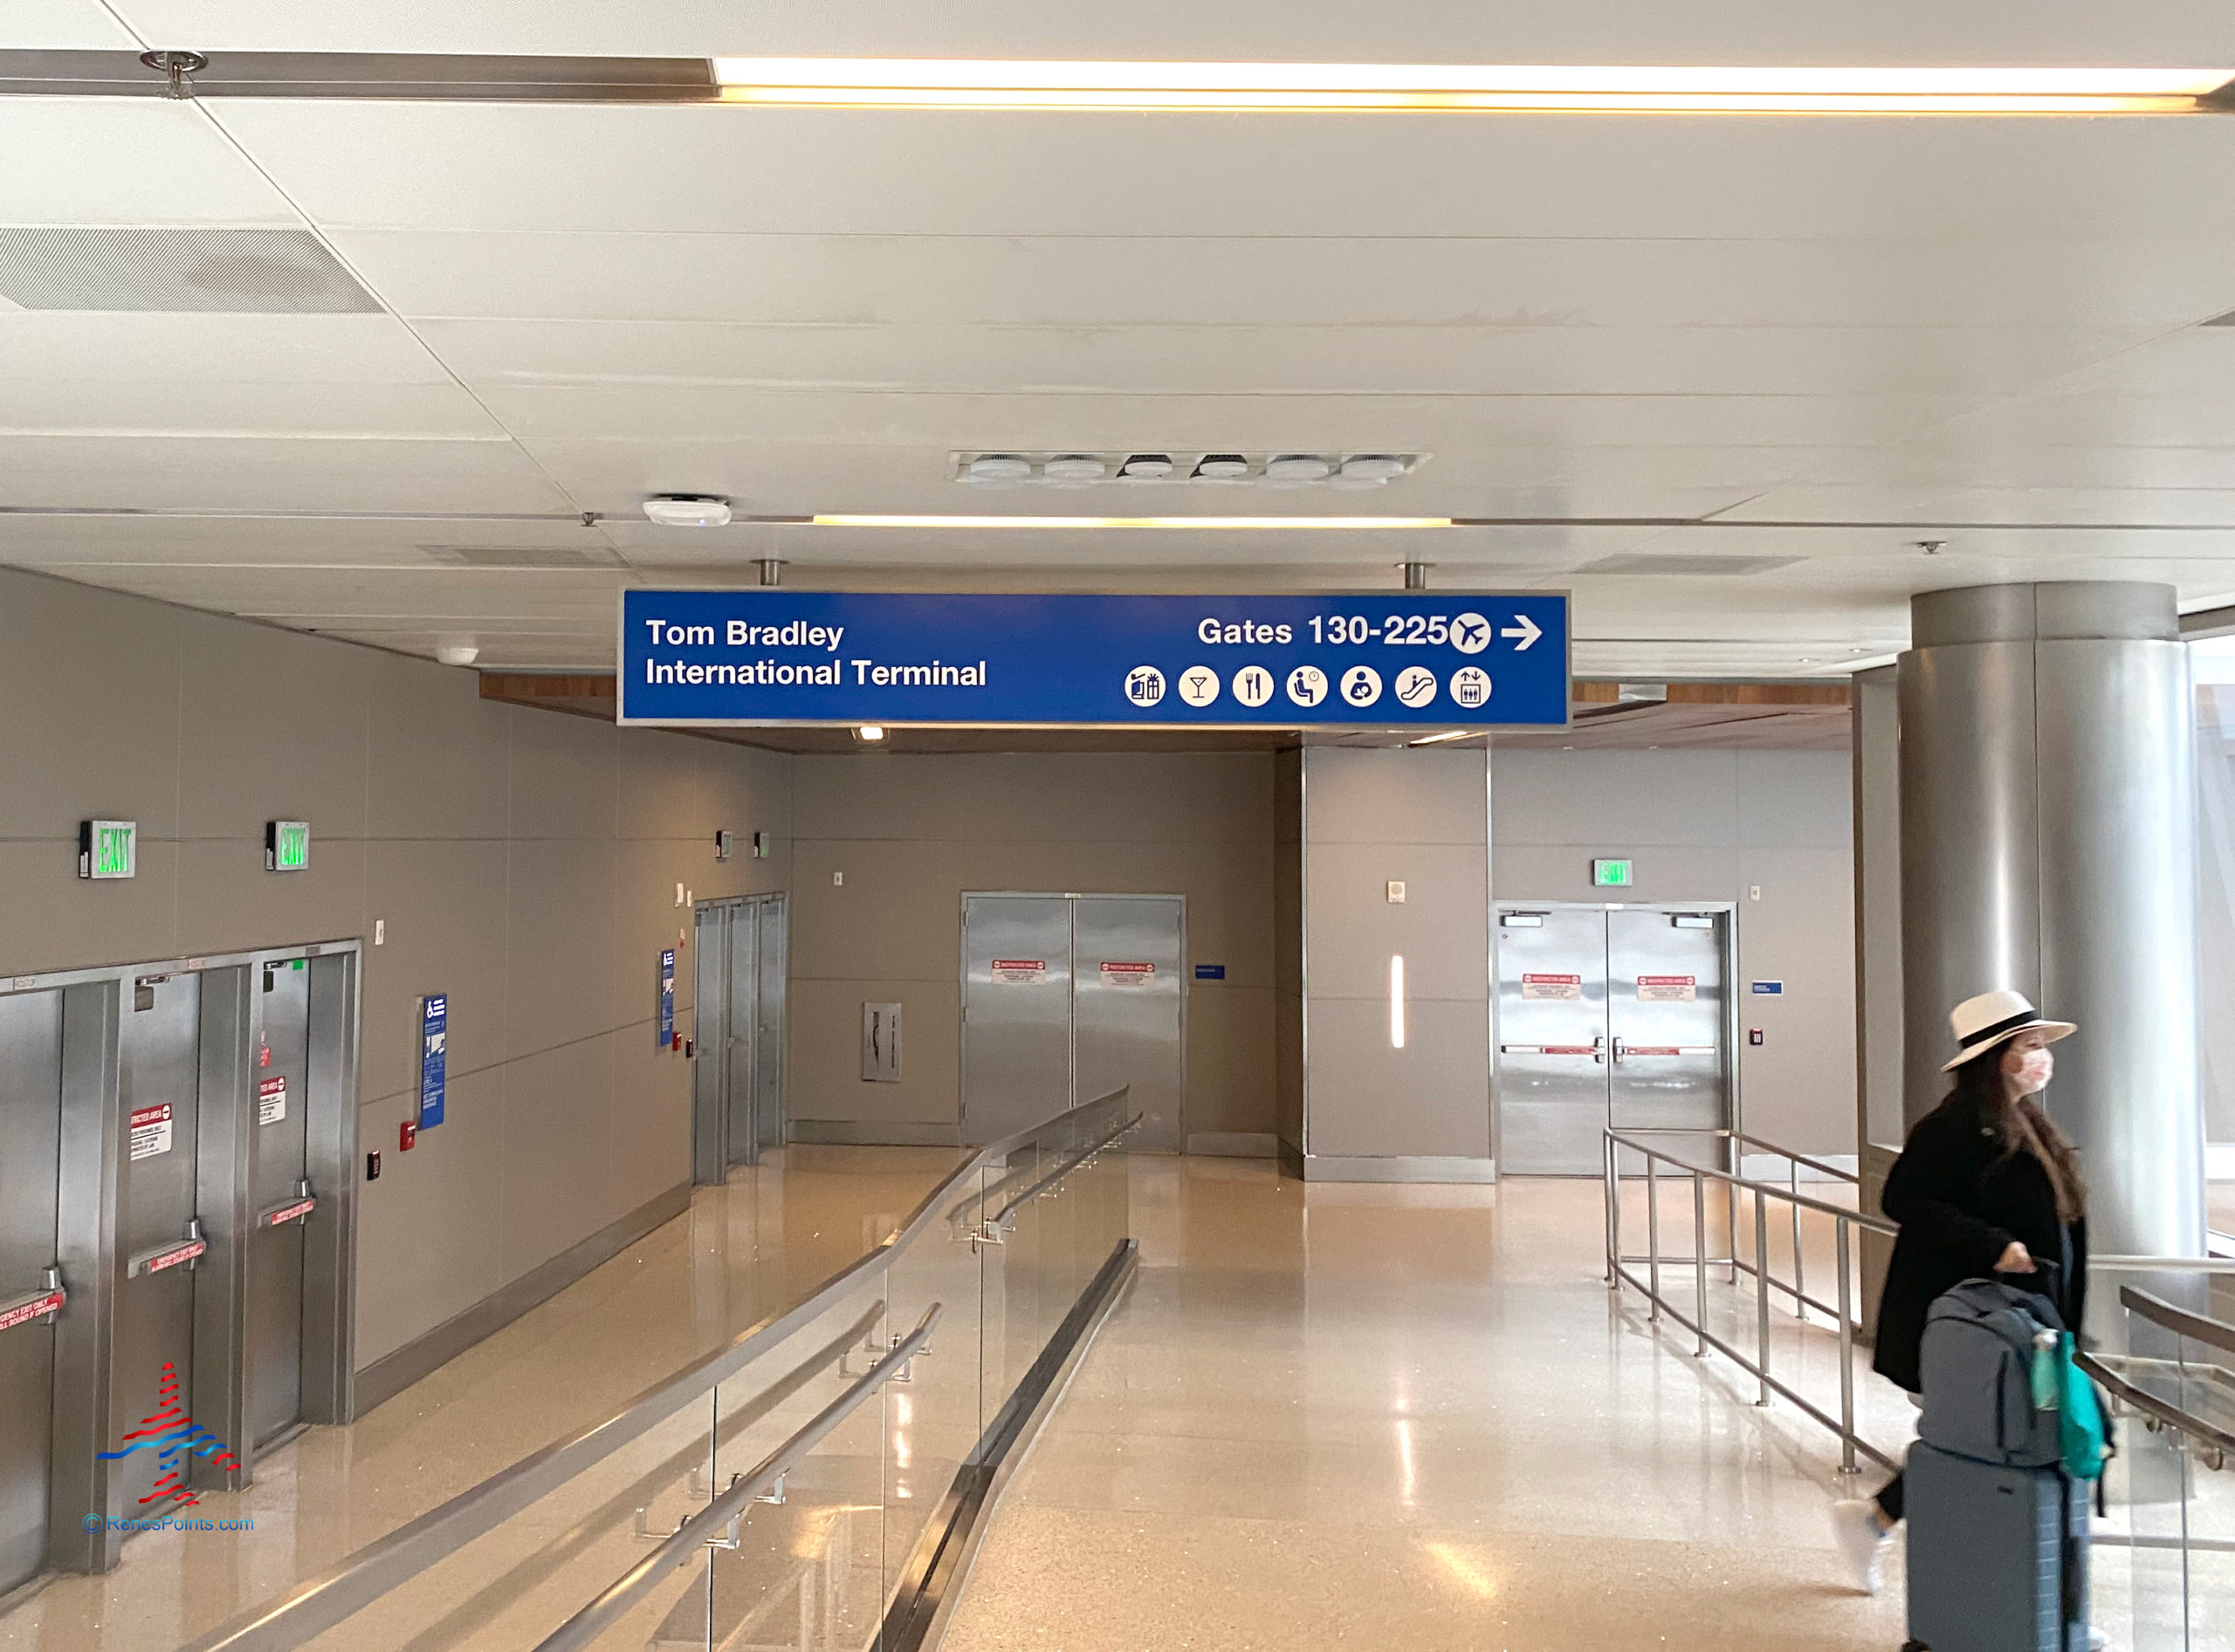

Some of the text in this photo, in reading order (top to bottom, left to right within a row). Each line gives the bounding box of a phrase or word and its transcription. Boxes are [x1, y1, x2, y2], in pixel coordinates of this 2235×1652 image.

[645, 620, 844, 651] Tom Bradley
[1198, 616, 1448, 644] Gates 130-225
[646, 658, 986, 685] International Terminal
[99, 829, 131, 872] EXIT
[280, 828, 306, 865] EXIT
[1599, 862, 1627, 884] EXIT
[0, 1298, 48, 1323] GENCY EXIT ONLY
[9, 1314, 29, 1327] SOUND
[35, 1302, 58, 1317] OPENED
